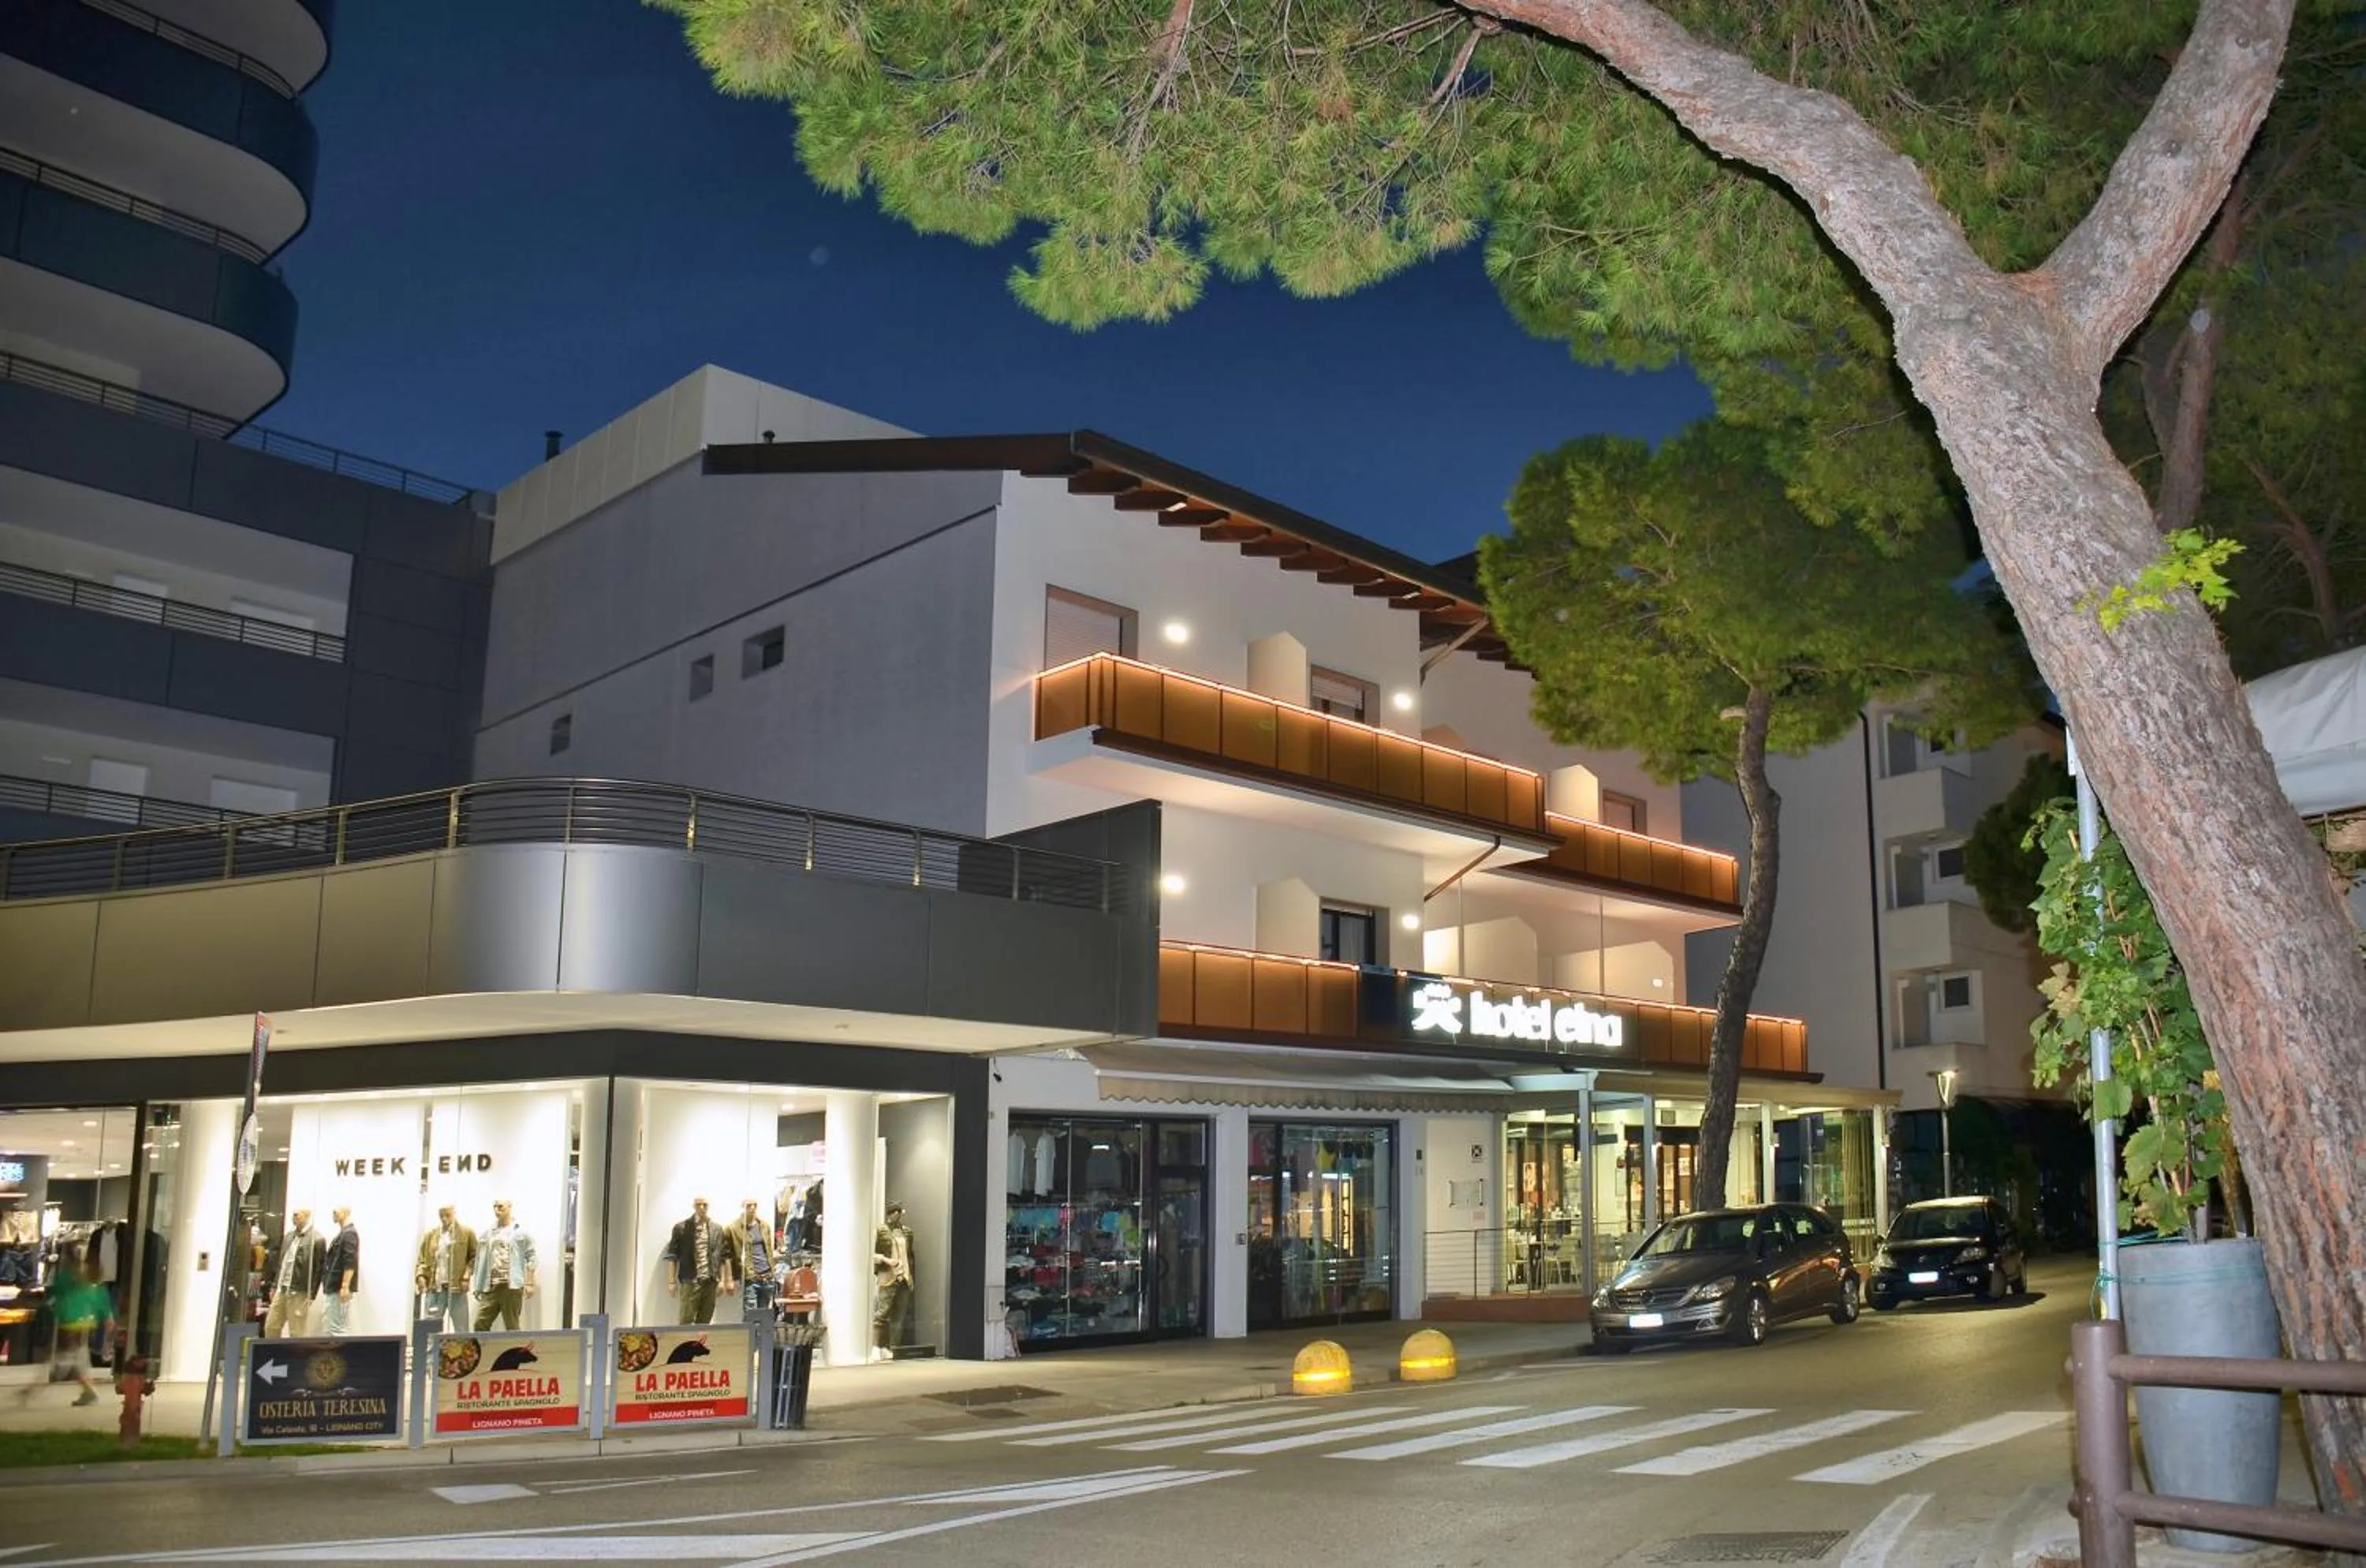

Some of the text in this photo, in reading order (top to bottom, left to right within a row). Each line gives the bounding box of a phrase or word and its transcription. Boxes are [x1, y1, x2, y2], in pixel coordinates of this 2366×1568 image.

[1470, 991, 1551, 1040] hotel
[335, 1157, 405, 1176] WEEK
[456, 1376, 560, 1400] LA PAELLA
[635, 1369, 730, 1392] LA PAELLA
[456, 1397, 561, 1409] RISTORANTE SPAGNOLO
[635, 1389, 732, 1402] RISTORANTE SPAGNOLO
[259, 1398, 386, 1418] OSTERIA TERESINA
[649, 1408, 715, 1420] LIGNANO PINETA
[472, 1417, 543, 1428] LIGNANO PINETA
